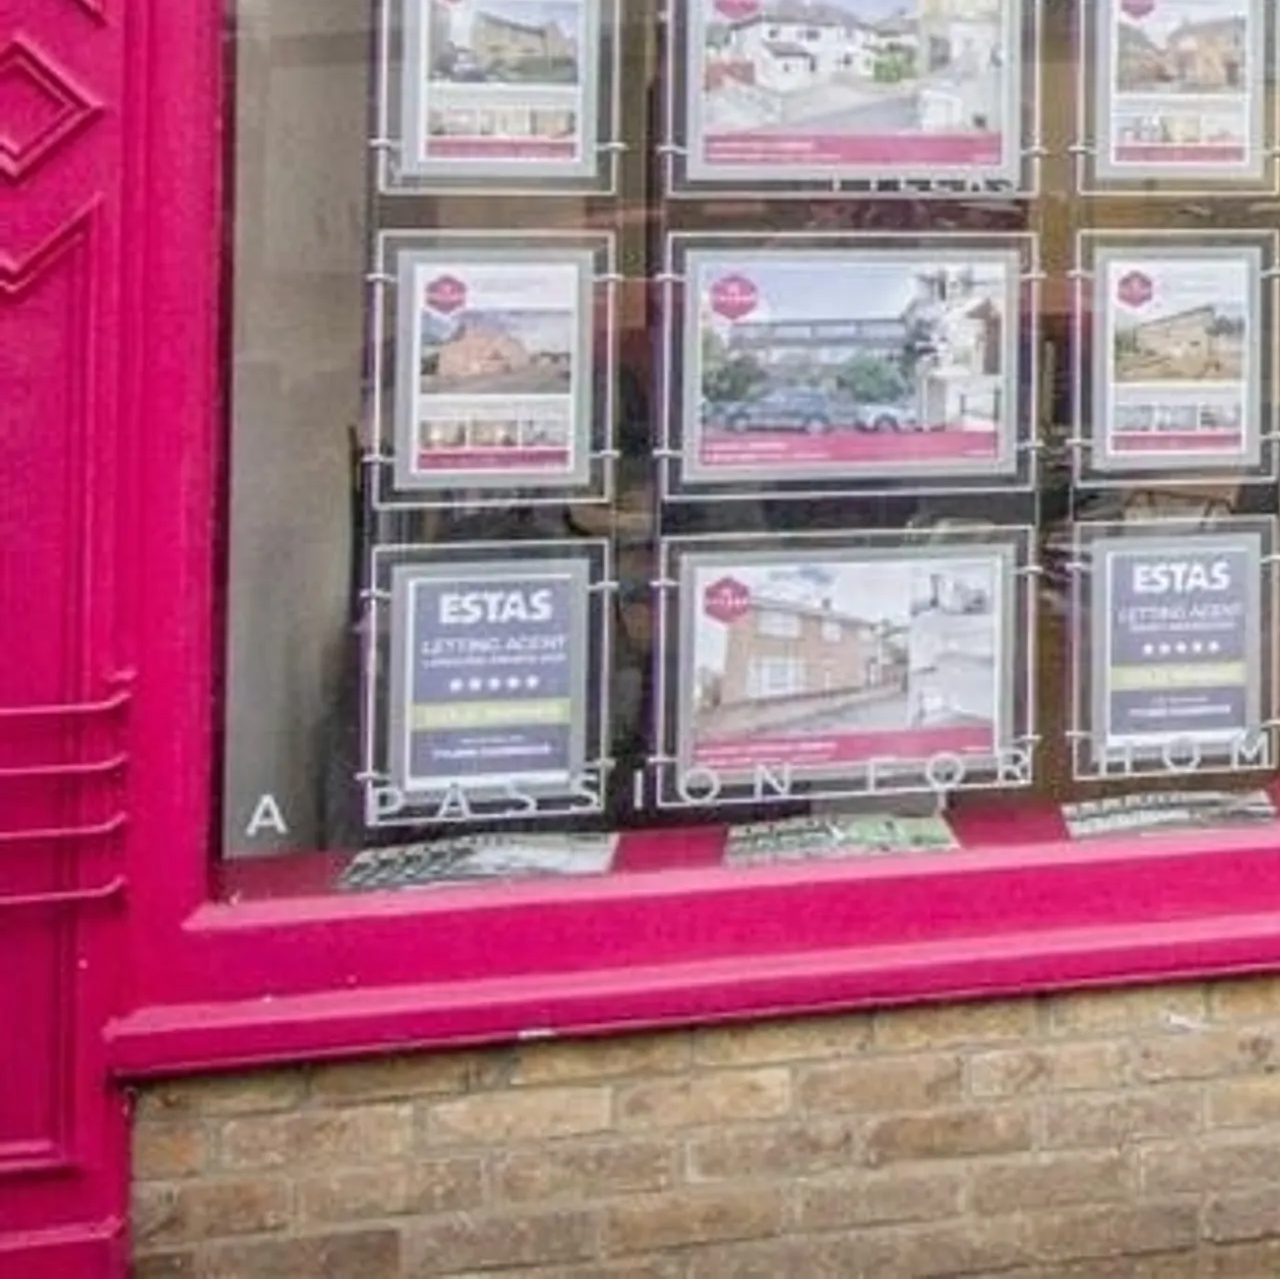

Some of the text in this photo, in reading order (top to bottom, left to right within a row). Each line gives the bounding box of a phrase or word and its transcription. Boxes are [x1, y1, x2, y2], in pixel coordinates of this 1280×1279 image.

[1132, 560, 1232, 593] ESTAS
[440, 589, 555, 624] ESTAS
[245, 794, 288, 835] A
[373, 763, 792, 818] PASSION
[868, 748, 1030, 794] FOR
